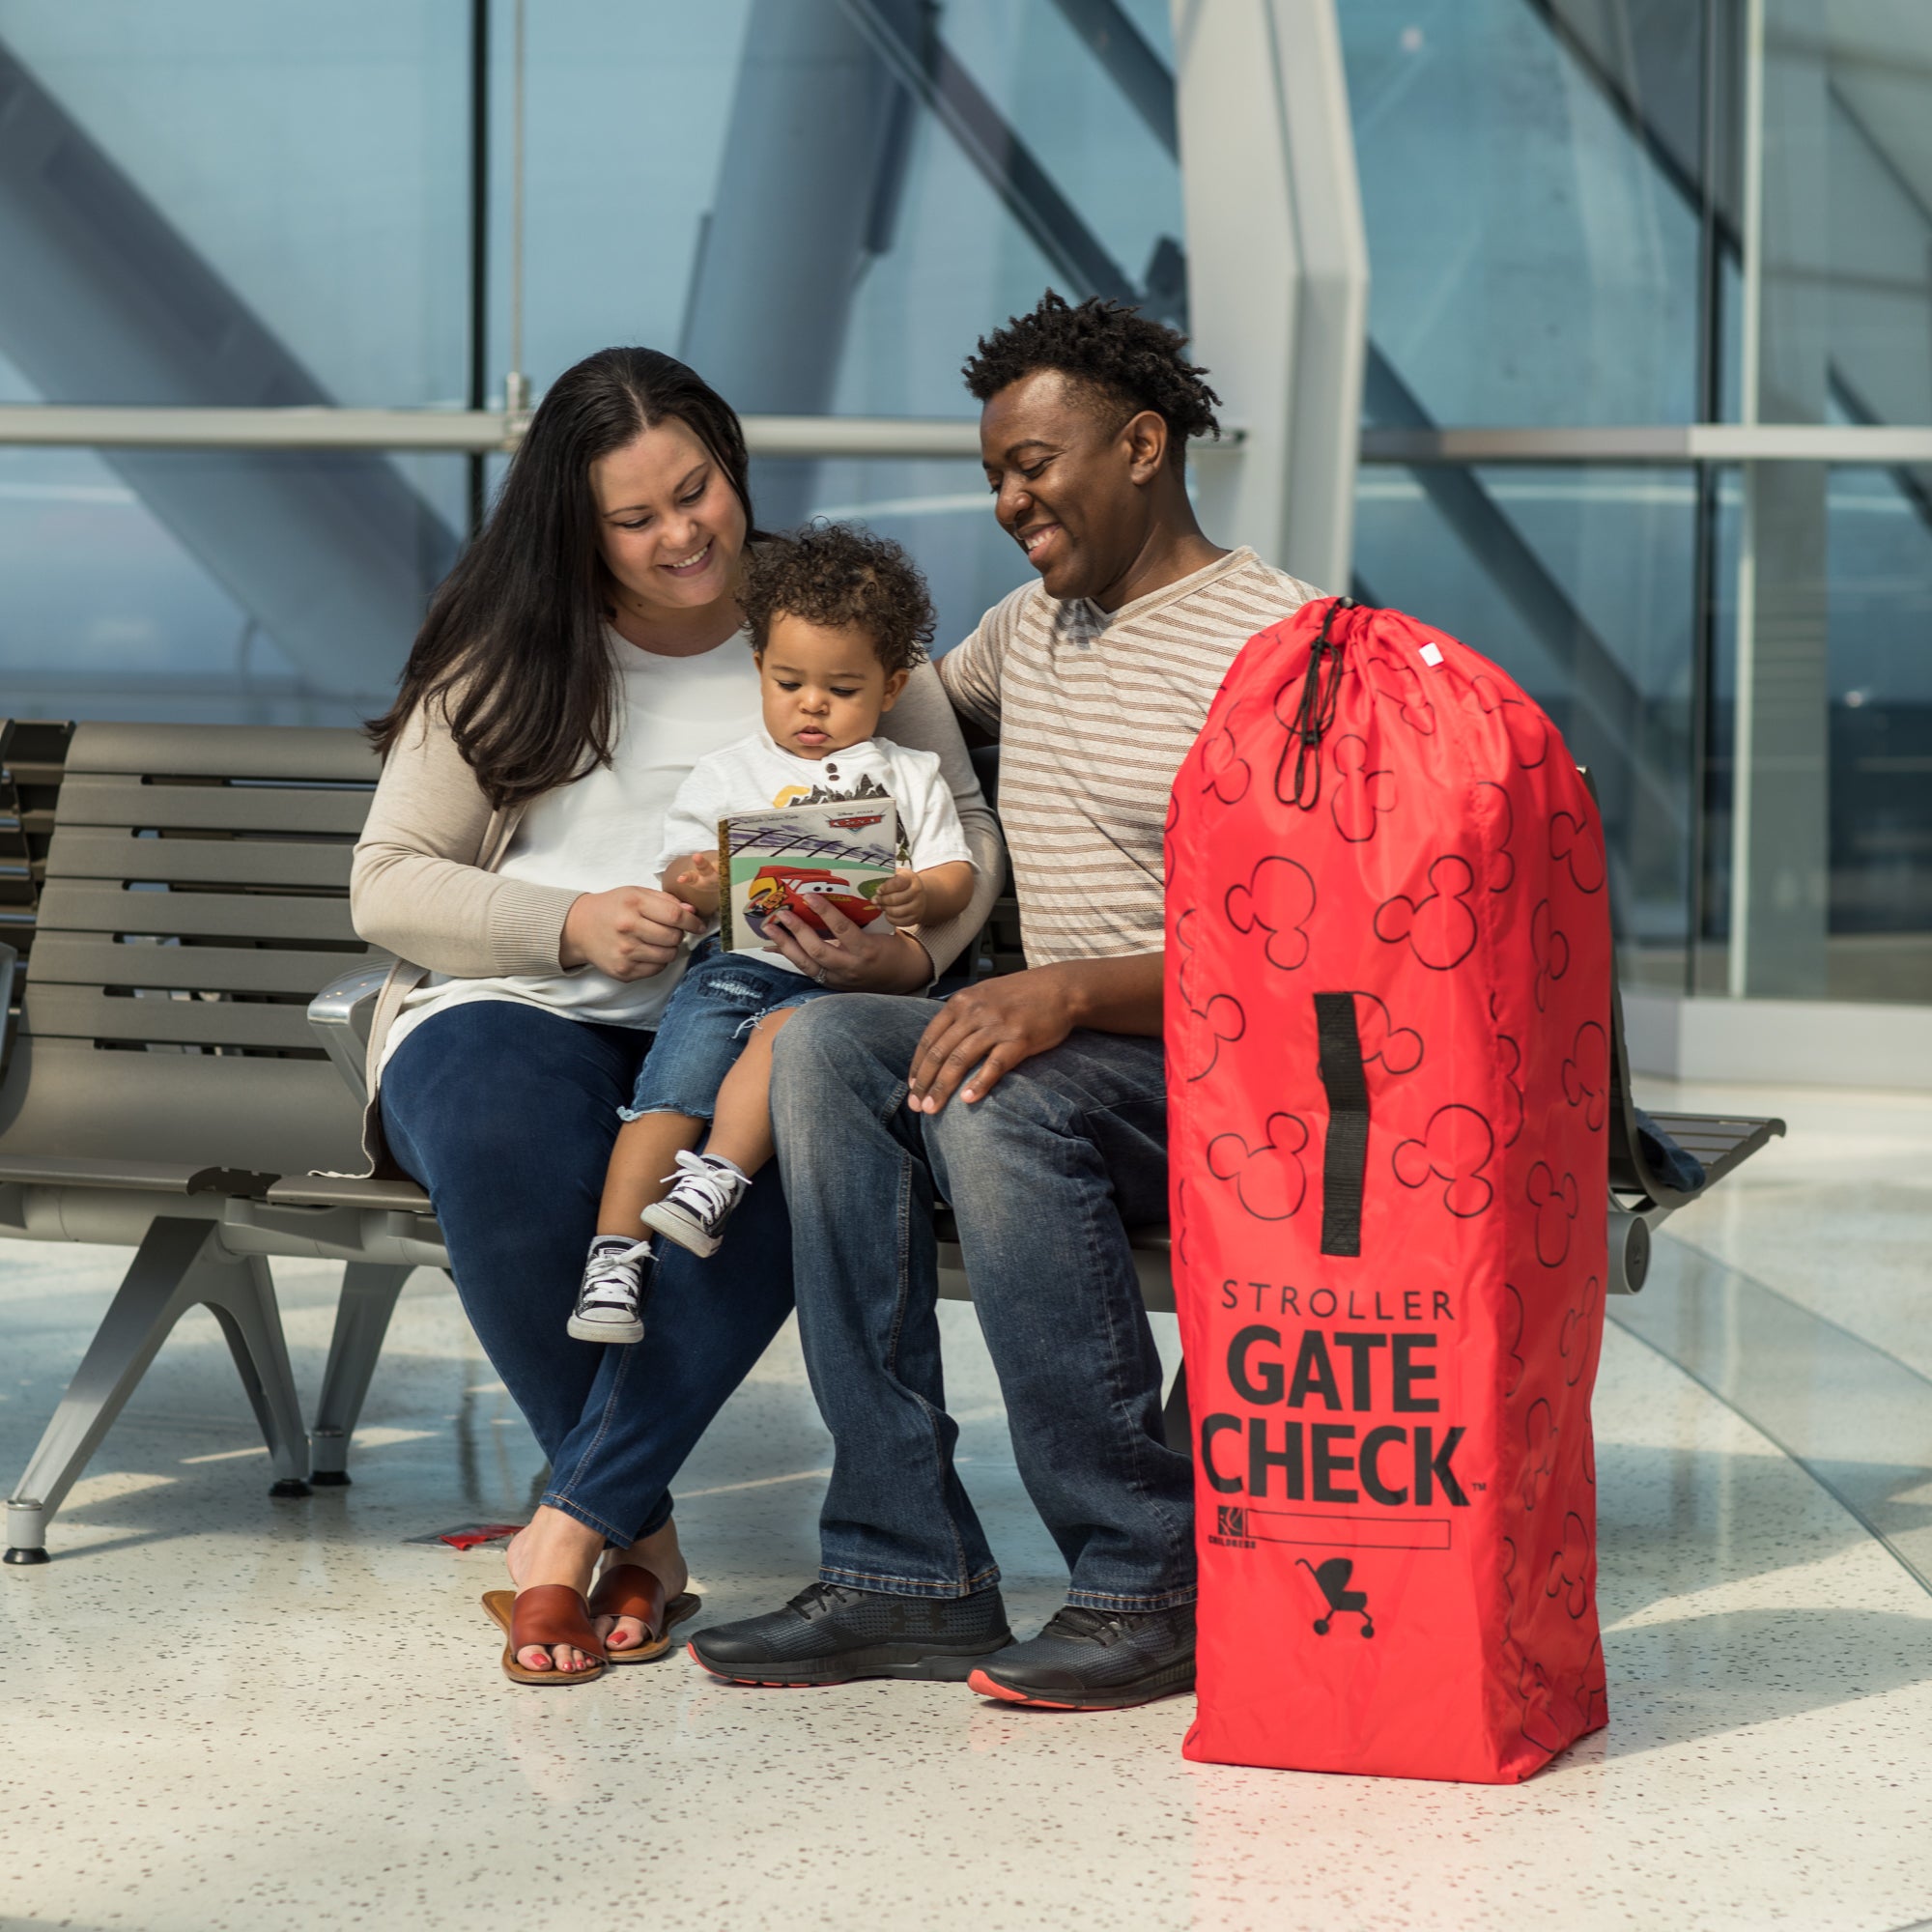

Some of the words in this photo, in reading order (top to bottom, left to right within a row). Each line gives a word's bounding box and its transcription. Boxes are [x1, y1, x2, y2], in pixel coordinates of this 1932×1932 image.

[1221, 1279, 1455, 1321] STROLLER
[1227, 1324, 1439, 1412] GATE
[1201, 1413, 1470, 1507] CHECK
